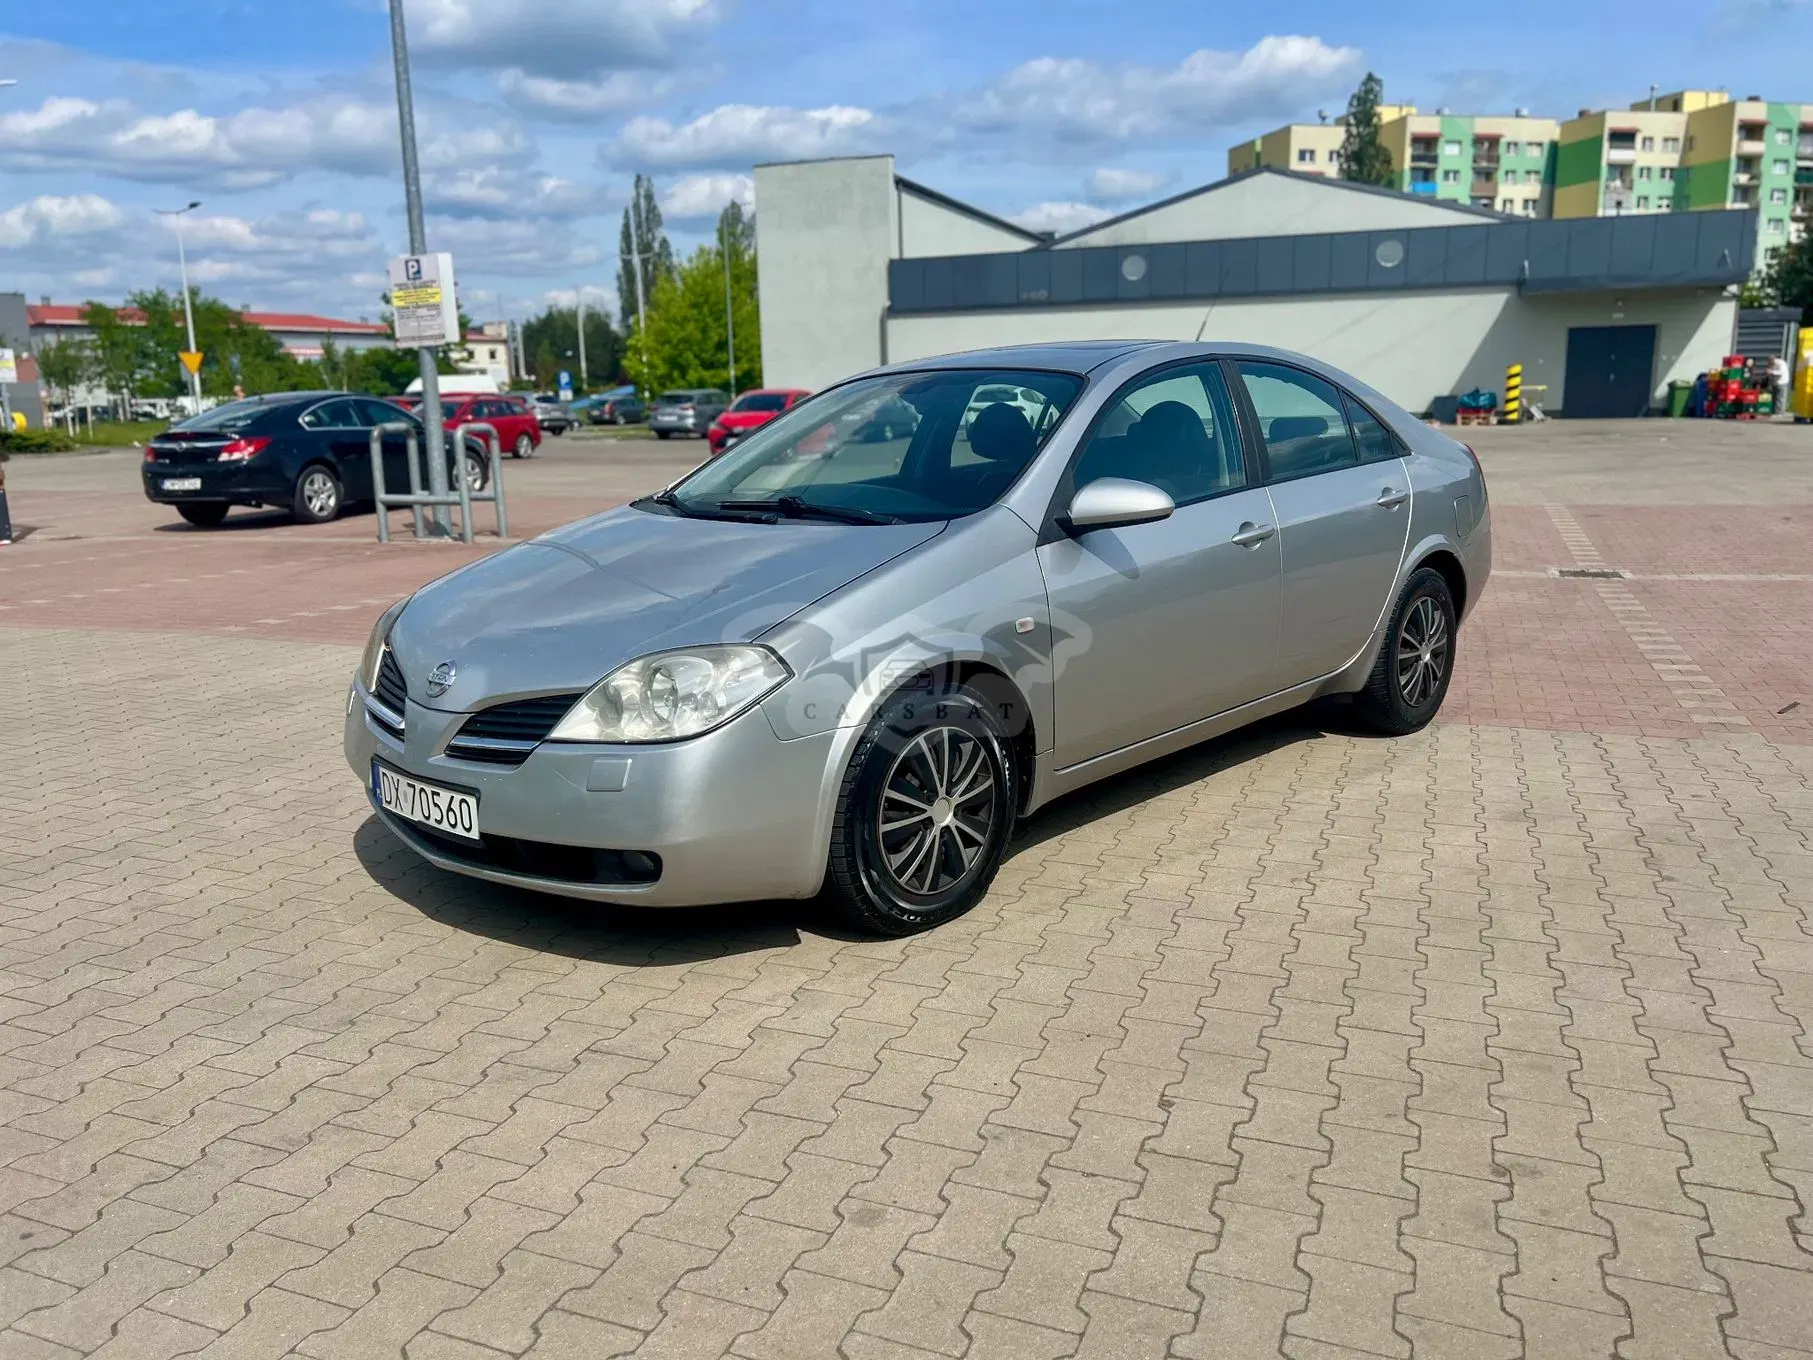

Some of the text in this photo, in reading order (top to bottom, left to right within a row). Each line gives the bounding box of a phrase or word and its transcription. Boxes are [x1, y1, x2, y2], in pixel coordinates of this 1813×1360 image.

[407, 260, 419, 278] P
[382, 771, 473, 833] DX 70560
